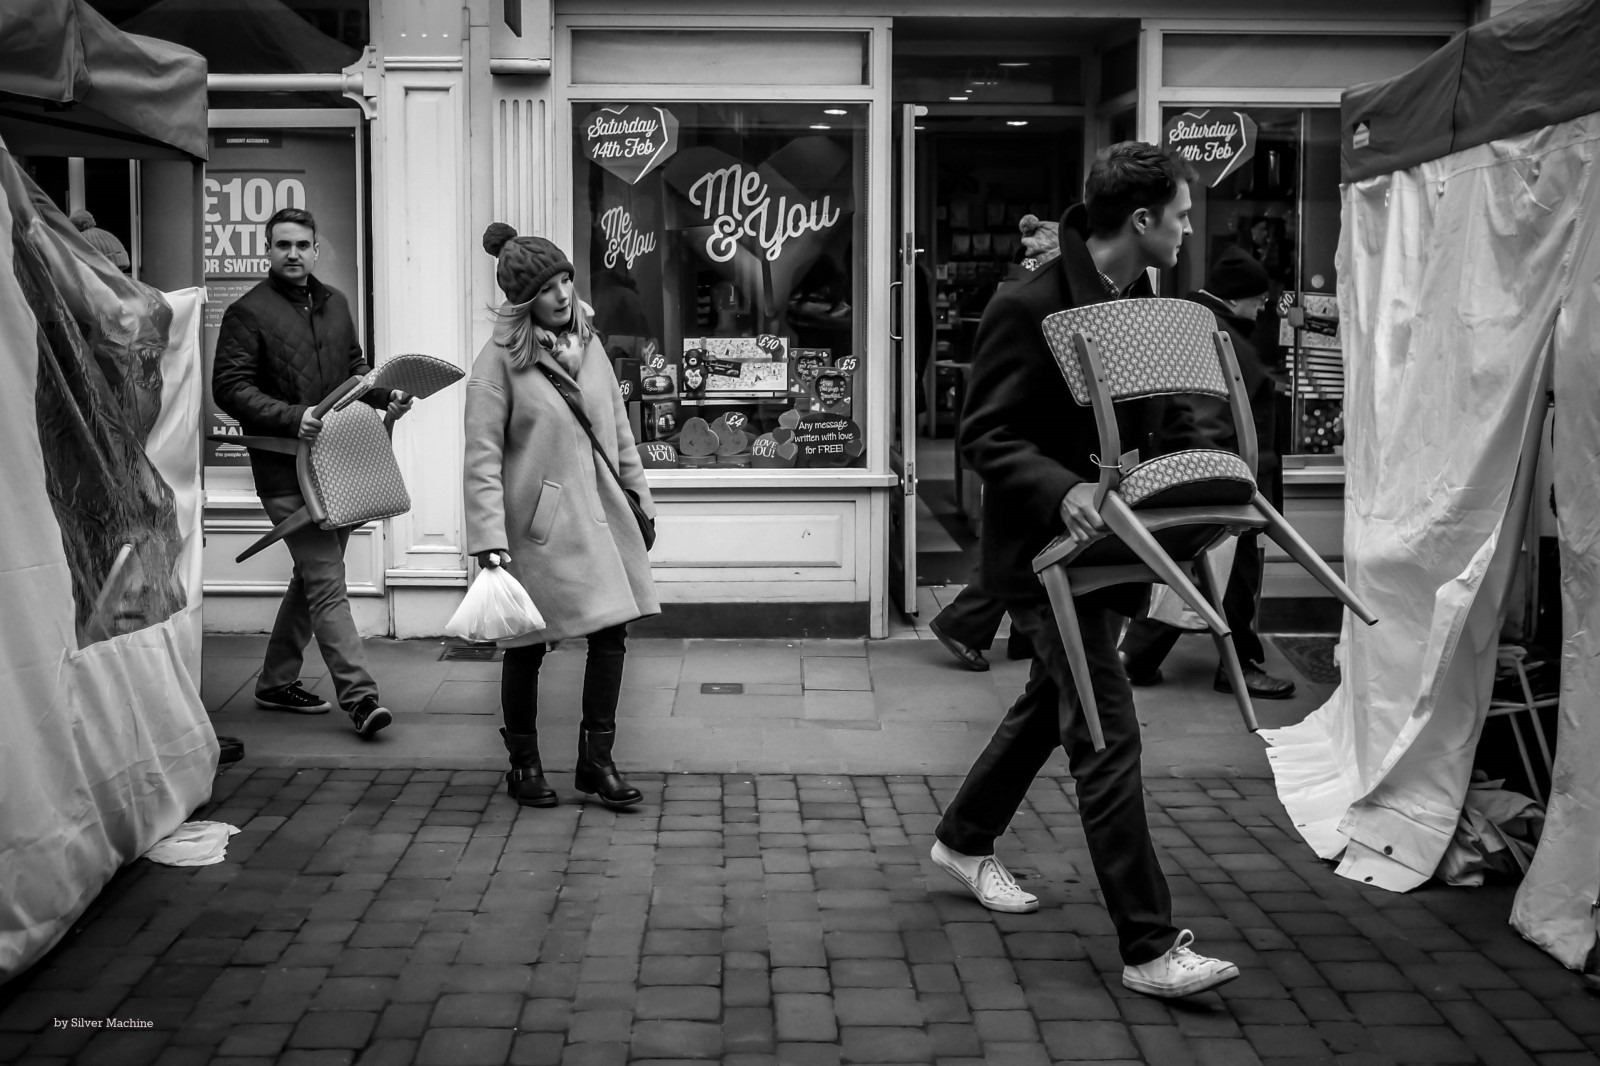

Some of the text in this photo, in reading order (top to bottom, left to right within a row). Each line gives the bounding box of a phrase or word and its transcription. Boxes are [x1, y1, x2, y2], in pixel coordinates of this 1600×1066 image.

[587, 116, 659, 141] Saturday
[1169, 120, 1239, 145] Saturday
[592, 137, 656, 159] 14th Feb
[1203, 141, 1234, 162] Feb
[688, 163, 769, 221] Me
[600, 205, 633, 242] Me
[705, 195, 841, 263] & You
[603, 228, 657, 270] & You
[758, 336, 780, 350] £10
[650, 357, 665, 369] £6
[840, 358, 857, 371] £5
[725, 415, 745, 428] £4
[798, 419, 849, 432] Any message
[794, 431, 854, 443] written with love
[805, 445, 816, 455] for
